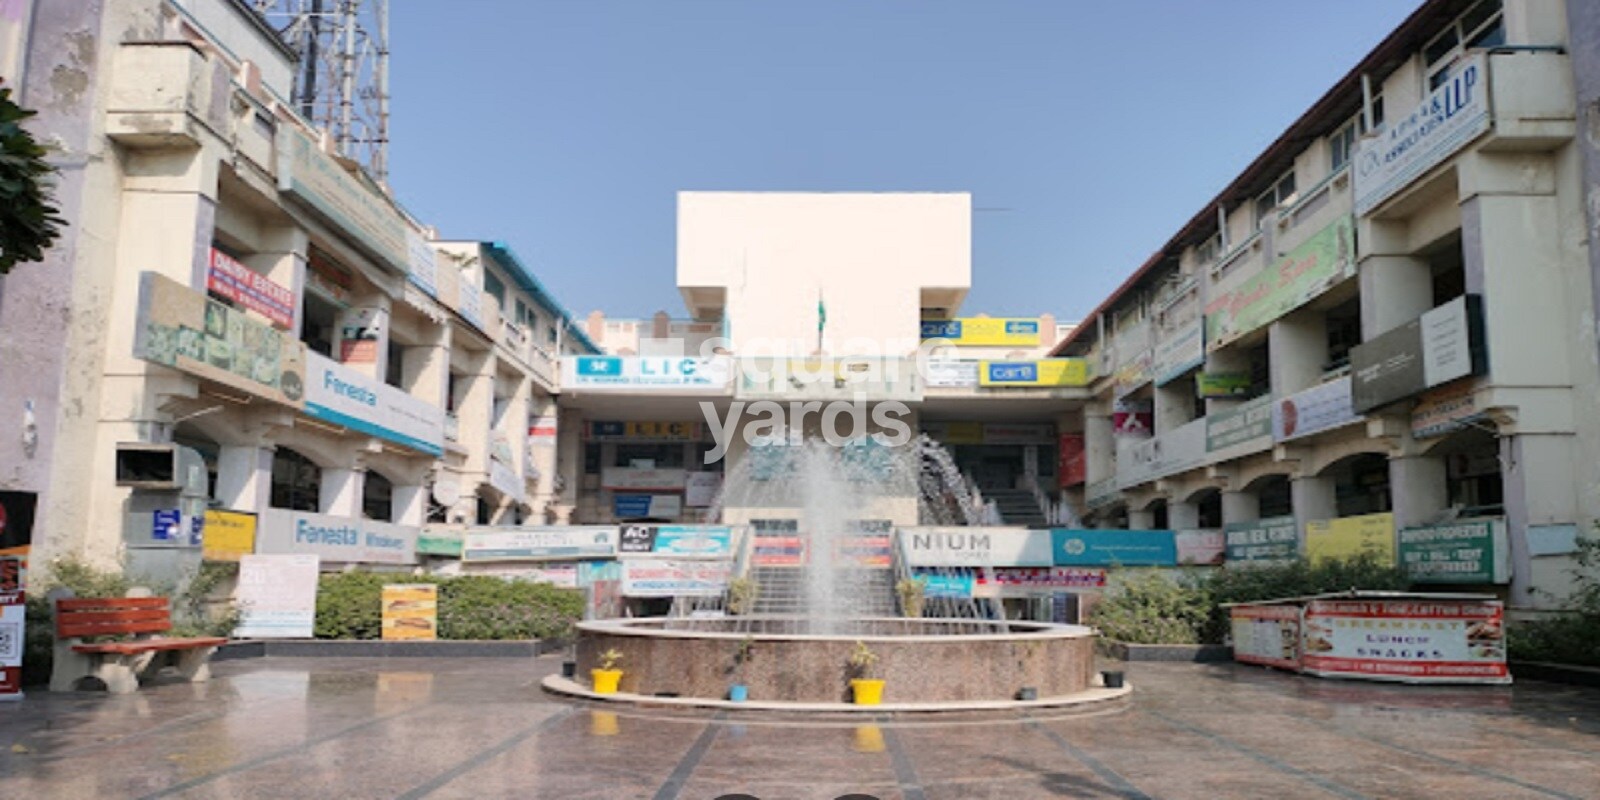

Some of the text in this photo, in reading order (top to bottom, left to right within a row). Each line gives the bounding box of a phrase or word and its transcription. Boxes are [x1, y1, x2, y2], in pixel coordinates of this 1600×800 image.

[1445, 65, 1477, 118] LLP
[641, 358, 697, 376] LIC
[324, 370, 377, 406] Fenesta
[635, 422, 682, 435] LIC
[296, 518, 357, 546] Fenesta
[622, 526, 650, 539] AC
[913, 534, 991, 550] NIUM
[1336, 619, 1459, 630] BREAKFAST
[1366, 633, 1431, 645] LUNCH
[1356, 648, 1444, 659] SNACKS
